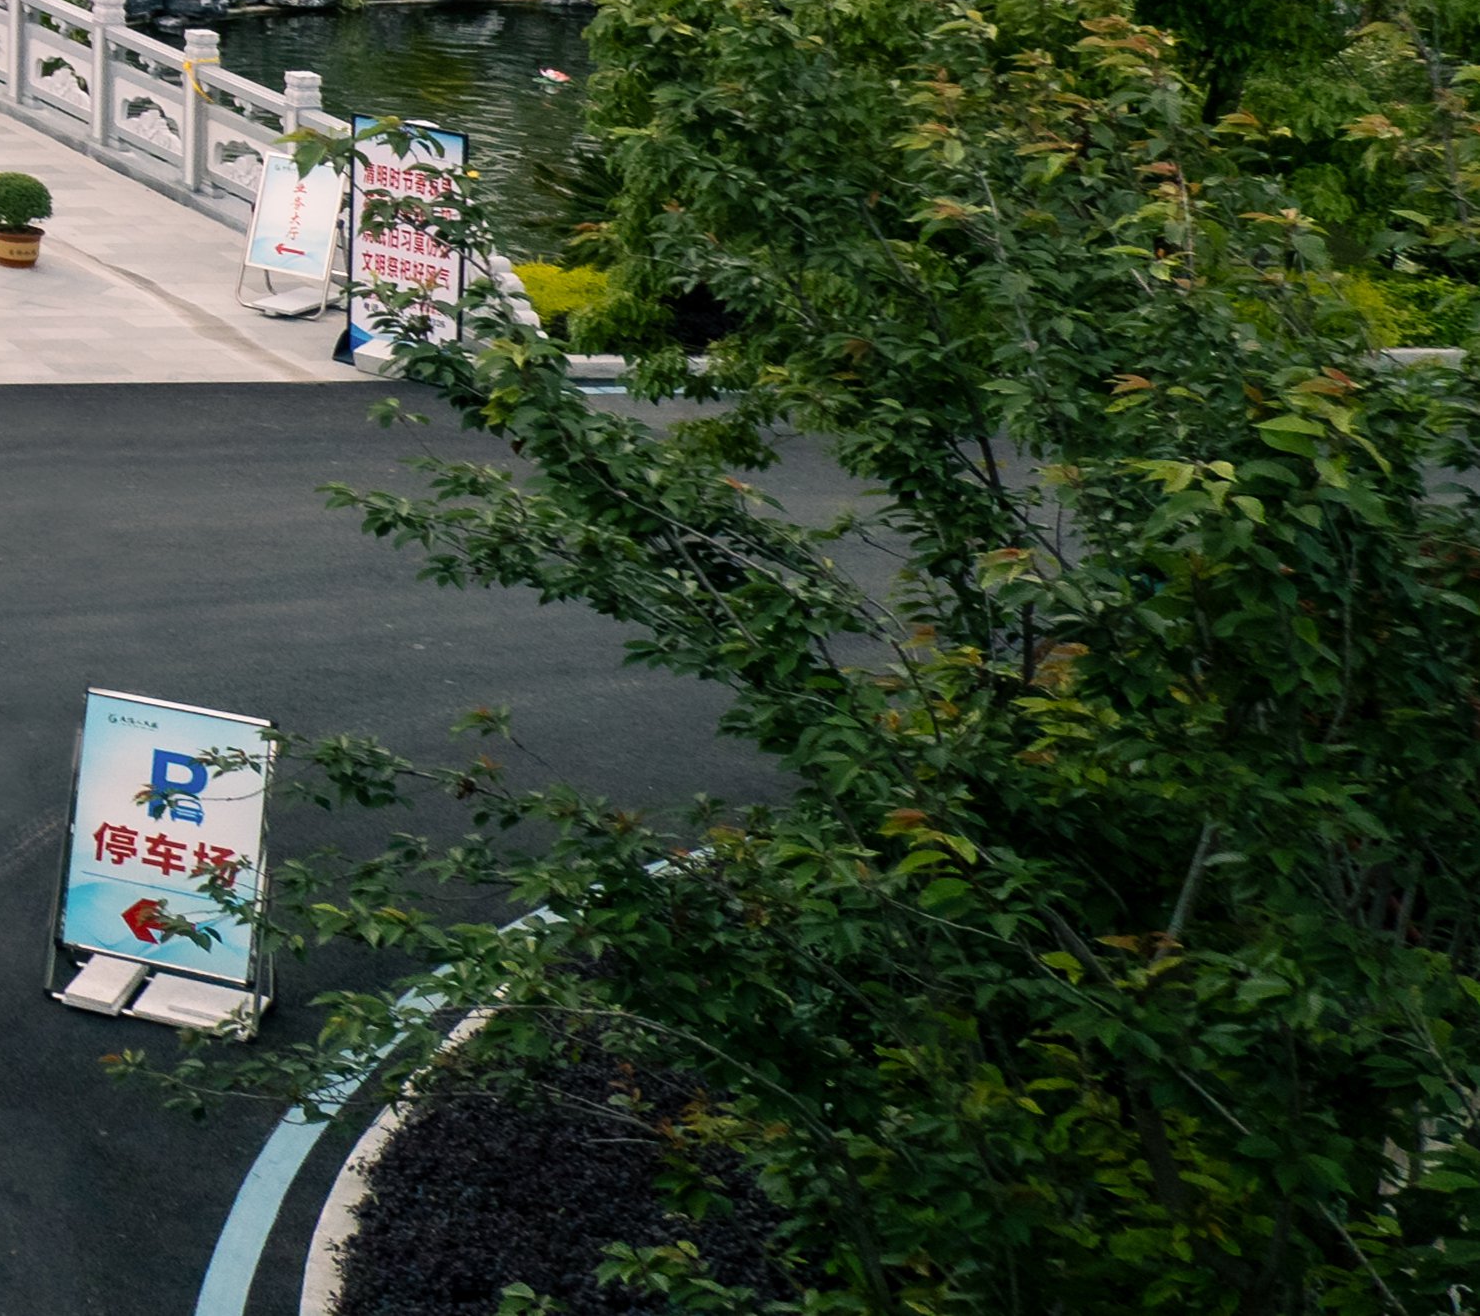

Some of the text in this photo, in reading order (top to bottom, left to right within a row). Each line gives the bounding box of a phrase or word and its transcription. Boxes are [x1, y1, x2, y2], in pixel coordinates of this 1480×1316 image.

[148, 748, 208, 820] P
[93, 821, 241, 888] 停车场
